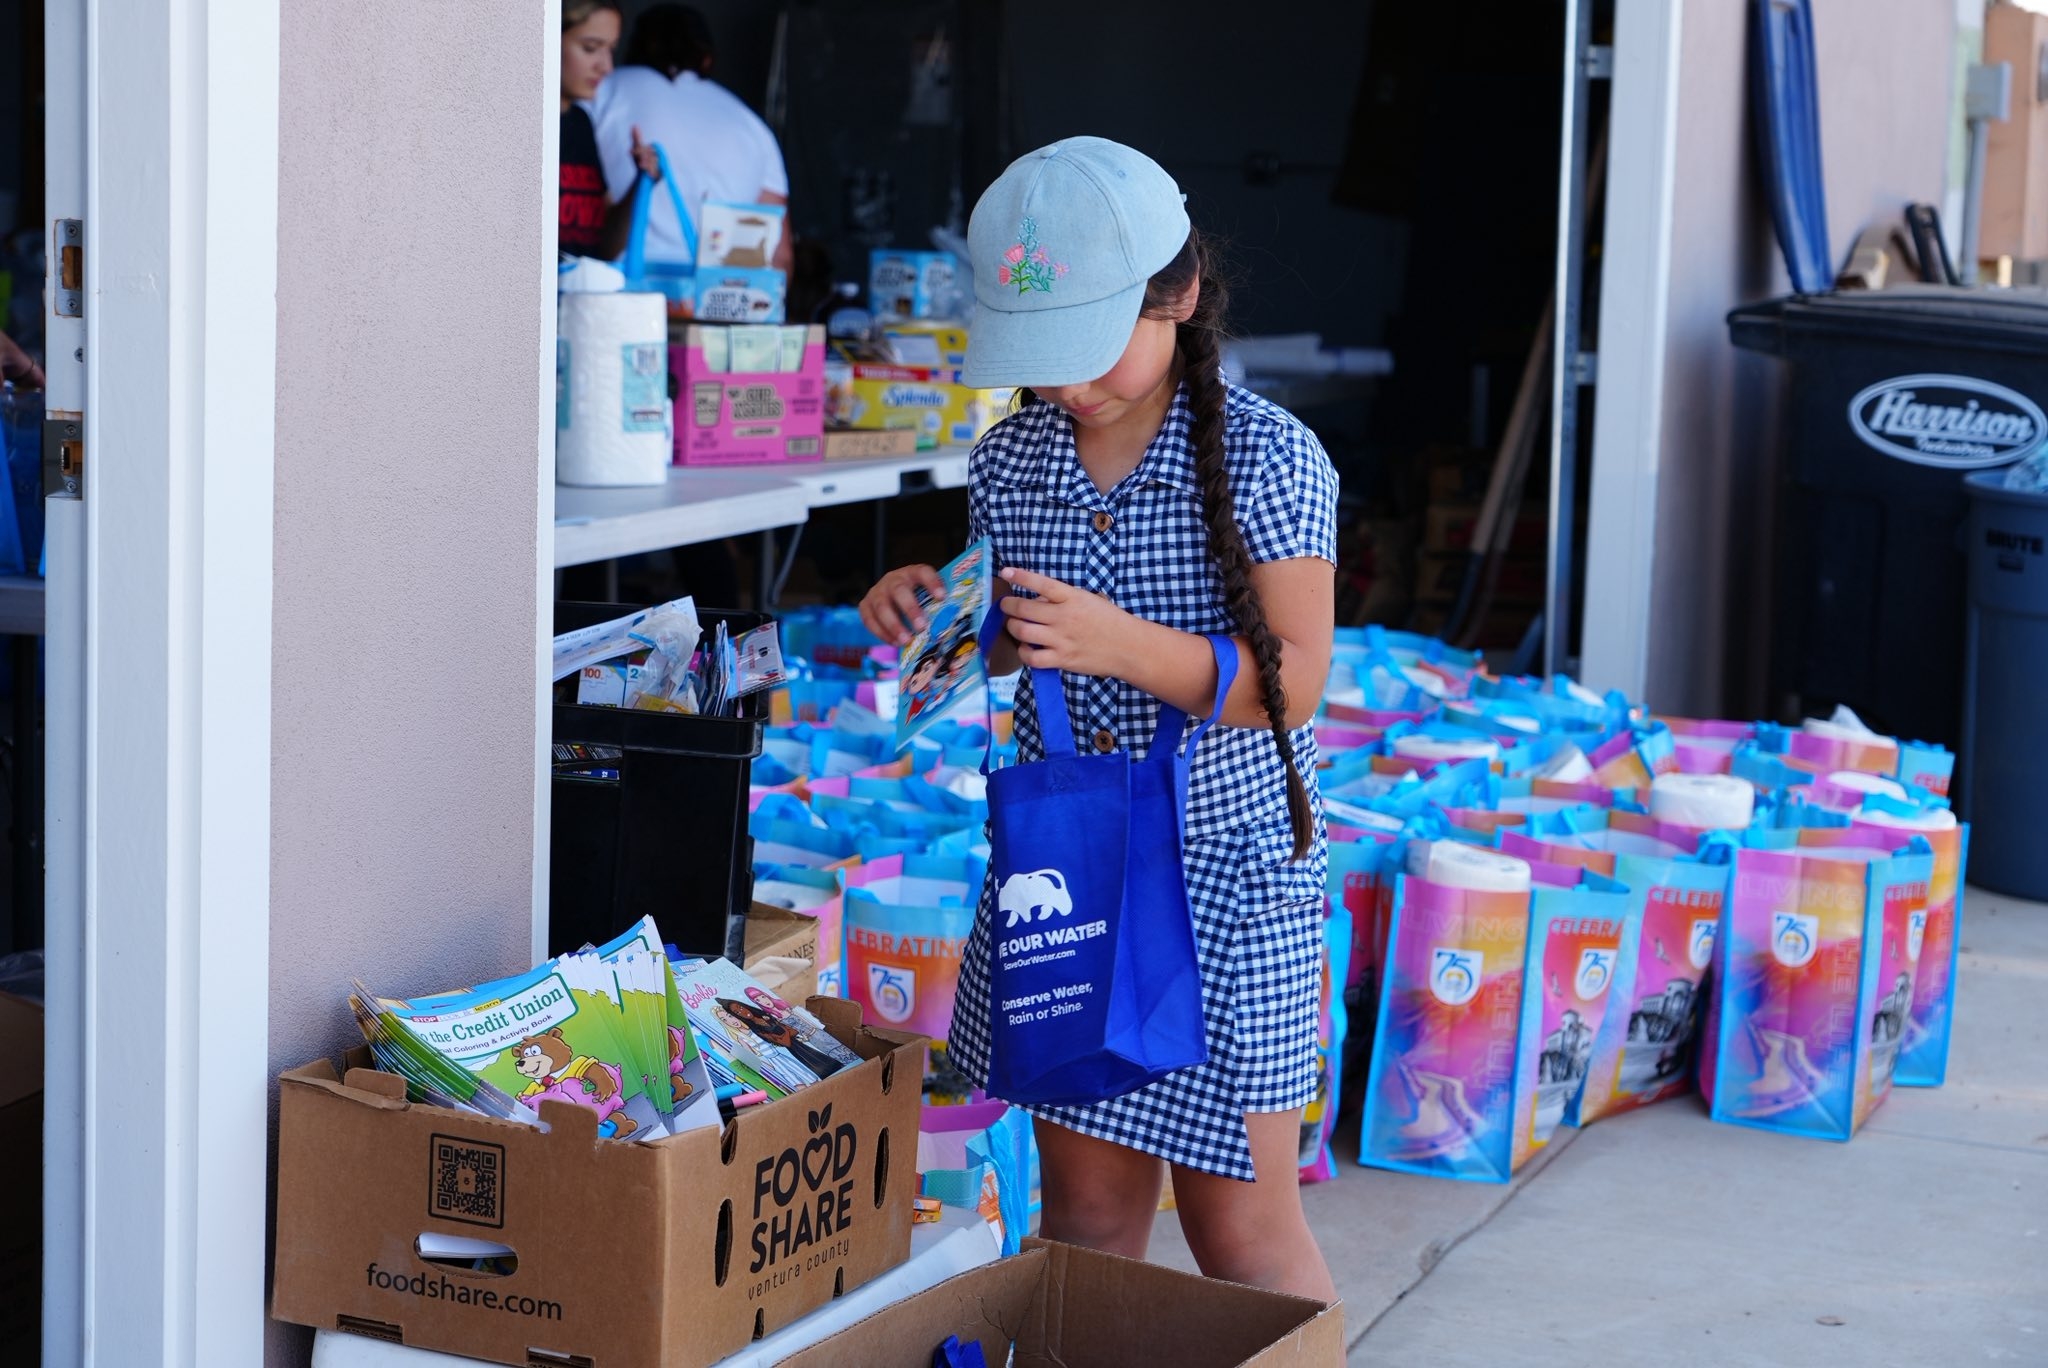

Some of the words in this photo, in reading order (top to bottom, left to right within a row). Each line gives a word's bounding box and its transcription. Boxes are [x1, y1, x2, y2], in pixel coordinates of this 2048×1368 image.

[1868, 389, 2035, 440] Harrison
[1003, 949, 1076, 971] SaveOurWater.com
[1008, 933, 1044, 955] OUR
[1044, 920, 1107, 947] WATER
[872, 966, 909, 1015] 75
[1436, 951, 1474, 994] 75
[429, 1031, 452, 1043] the
[452, 1012, 509, 1042] Credit
[509, 988, 564, 1021] Union
[678, 983, 718, 1010] Barbie
[1002, 992, 1051, 1011] Conserve
[1052, 982, 1093, 1000] Water,
[1009, 1010, 1034, 1026] Rain
[1037, 1008, 1049, 1020] or
[1051, 1001, 1084, 1018] Shine.
[454, 1041, 490, 1053] Coloring
[500, 1026, 530, 1042] Activity
[531, 1014, 553, 1028] Book
[753, 1122, 857, 1220] FOOD
[750, 1179, 854, 1274] SHARE
[366, 1262, 563, 1321] foodshare.com
[748, 1263, 801, 1301] ventura
[806, 1239, 850, 1272] county
